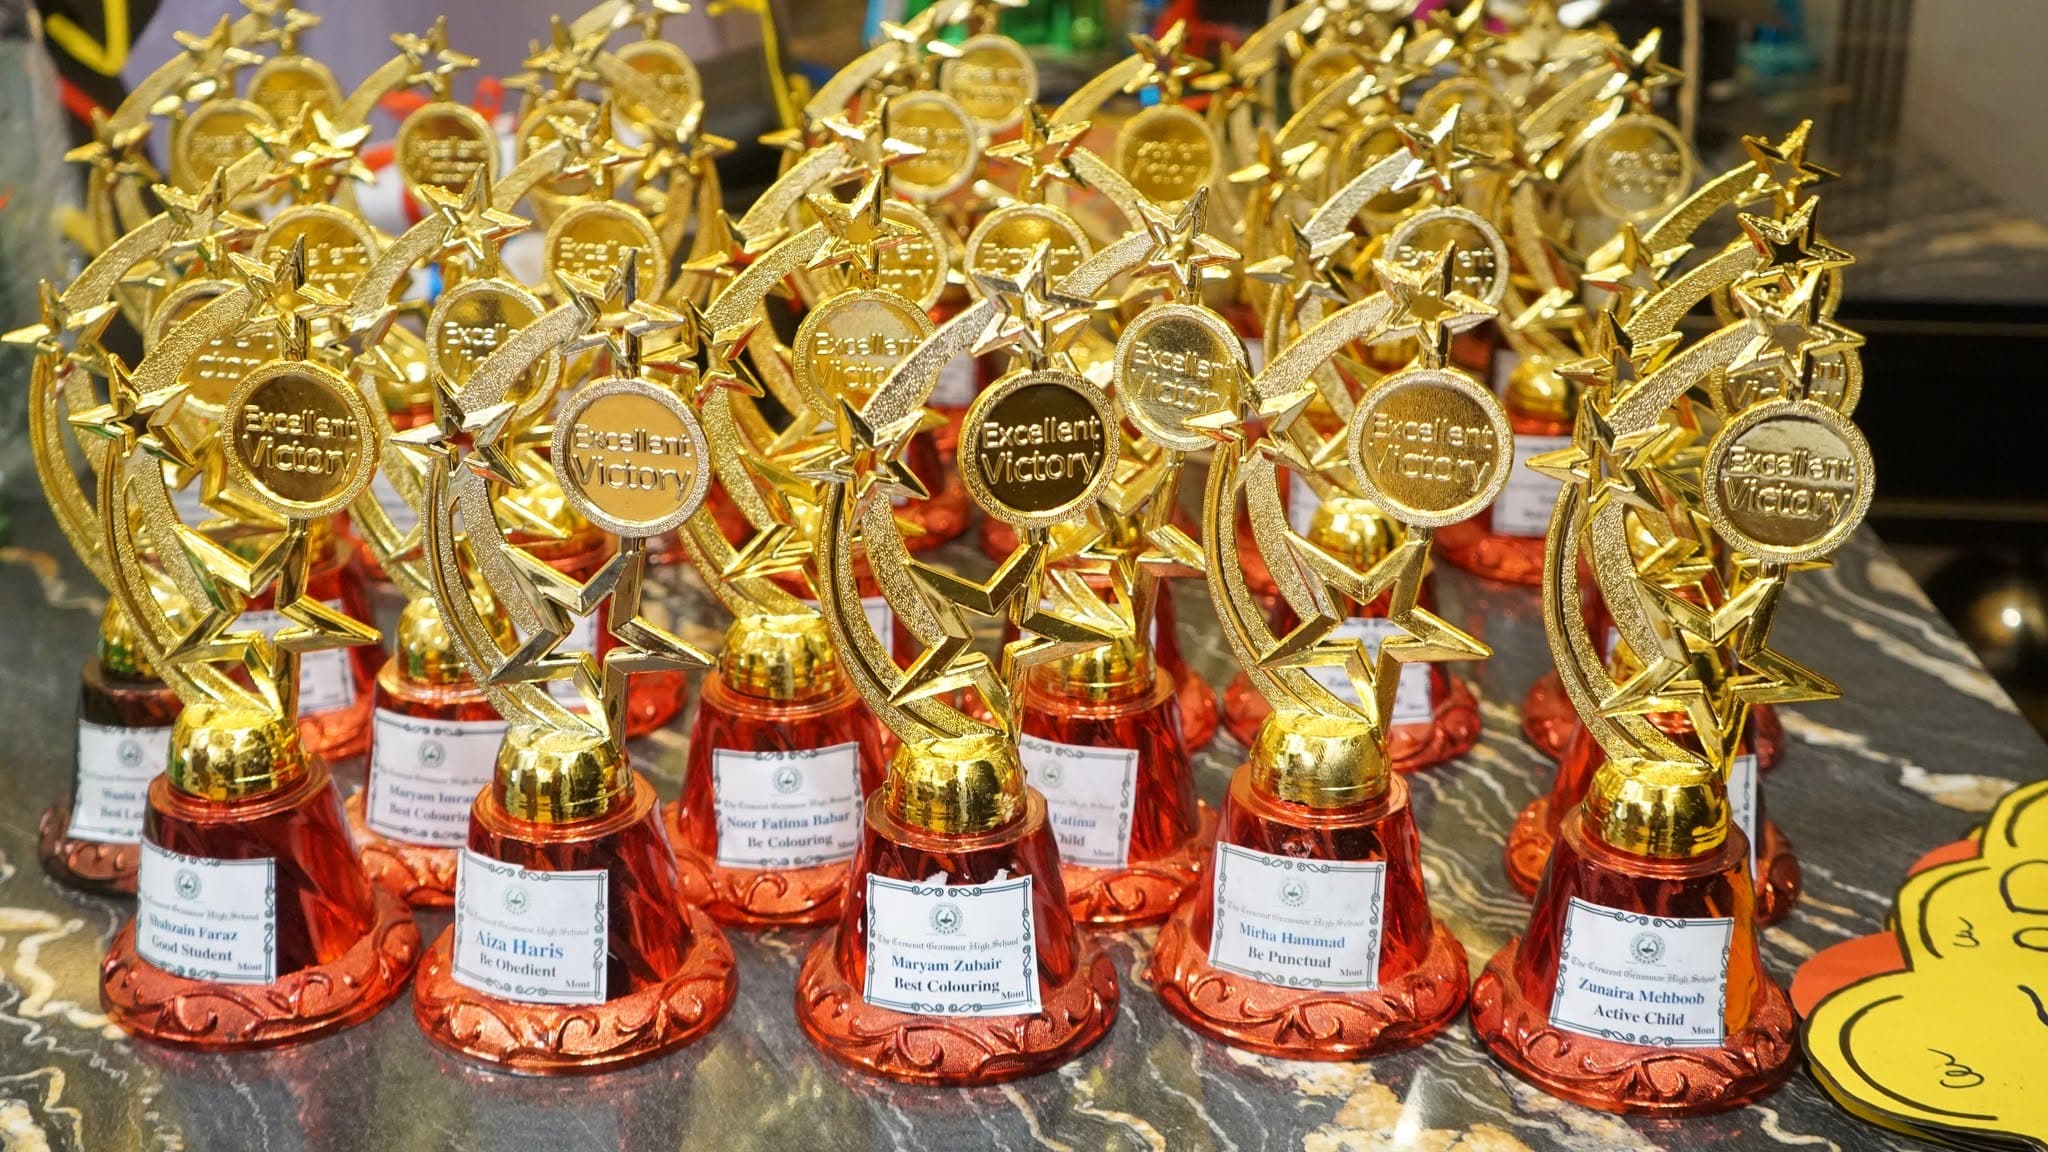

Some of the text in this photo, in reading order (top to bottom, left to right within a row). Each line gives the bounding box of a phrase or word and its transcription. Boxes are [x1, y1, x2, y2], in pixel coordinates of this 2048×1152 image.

[244, 404, 361, 440] Excellent
[982, 415, 1101, 449] Excellent
[1373, 412, 1494, 450] Excellent
[573, 424, 692, 458] Excellent
[241, 433, 357, 484] Victory
[980, 450, 1100, 485] Victory
[1368, 441, 1491, 493] Victory
[1728, 445, 1855, 482] Excellent
[572, 453, 691, 502] Victory
[1723, 476, 1851, 526] Victory
[414, 808, 470, 823] Colourin
[762, 816, 809, 830] Fatima
[747, 834, 833, 849] Be Colouring
[1058, 832, 1085, 847] hild
[152, 935, 232, 962] Good Student
[199, 927, 239, 942] Faraz
[475, 929, 565, 960] Aiza Haris
[1239, 921, 1346, 949] Mirha Hammad
[480, 953, 557, 979] Be Obedient
[891, 954, 1003, 974] Maryam Zubair
[1248, 946, 1332, 970] Be Punctual
[894, 976, 1000, 995] Best Colouring
[1578, 977, 1705, 1006] Zunaira Mehboob
[1593, 1004, 1685, 1027] Active Child
